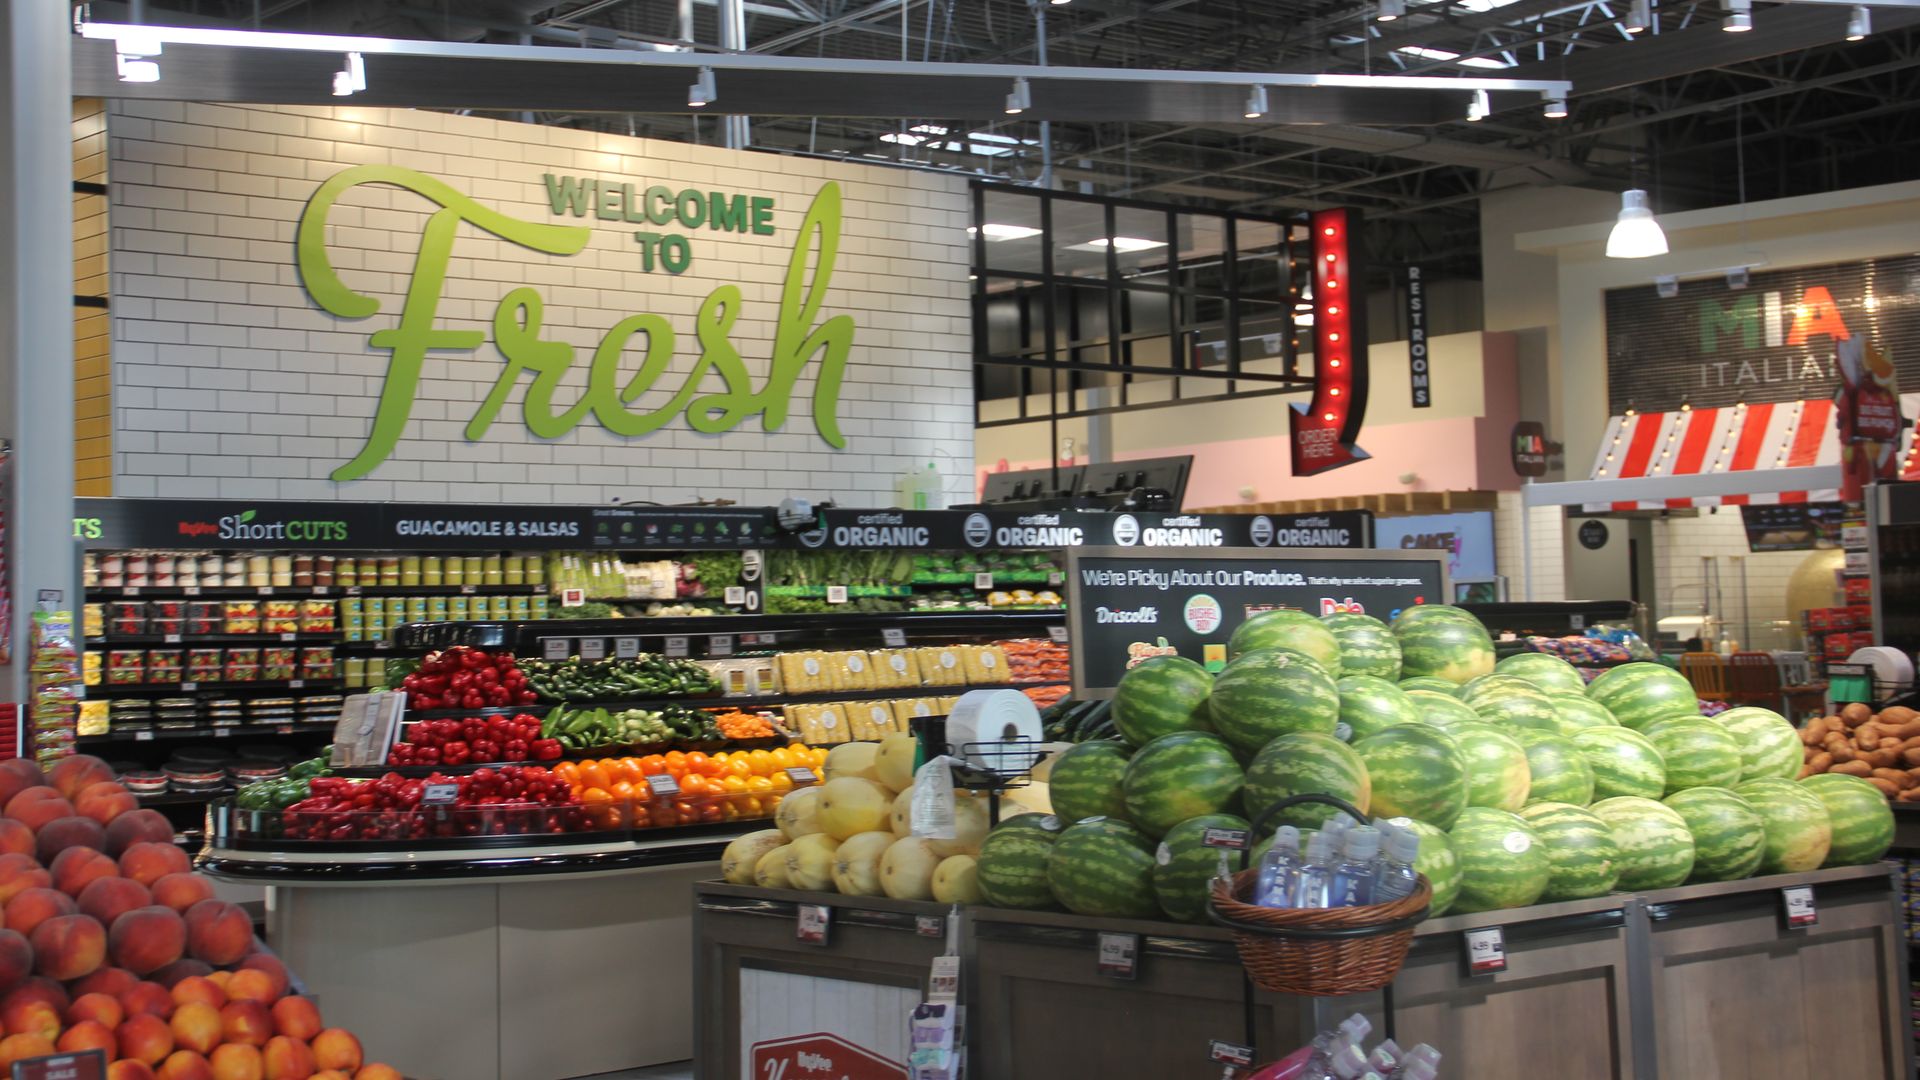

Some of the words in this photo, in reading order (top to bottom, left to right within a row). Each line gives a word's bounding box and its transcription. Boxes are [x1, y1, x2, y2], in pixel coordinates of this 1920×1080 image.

[544, 173, 776, 236] WELCOME
[634, 231, 692, 274] TO
[298, 163, 855, 482] Fresh
[1700, 286, 1850, 353] MIA
[1408, 266, 1428, 404] RESTROOMS
[1298, 428, 1337, 445] ORDER
[1516, 434, 1545, 453] MIA
[1303, 443, 1334, 459] HERE
[396, 520, 501, 536] GUACAMOLE
[503, 521, 516, 537] &
[518, 521, 579, 537] SALSAS
[857, 513, 904, 526] certified
[1017, 514, 1060, 526] certified
[1161, 515, 1202, 527] certified
[1294, 516, 1331, 528] certified
[833, 526, 930, 547] ORGANIC
[995, 527, 1084, 547] ORGANIC
[1142, 527, 1223, 547] ORGANIC
[1277, 528, 1350, 546] ORGANIC
[1082, 569, 1127, 586] We're
[1127, 569, 1170, 590] Picky
[1169, 569, 1215, 586] About
[1215, 570, 1241, 586] Our
[1243, 569, 1307, 586] Produce.
[1095, 606, 1159, 624] Driscoll's
